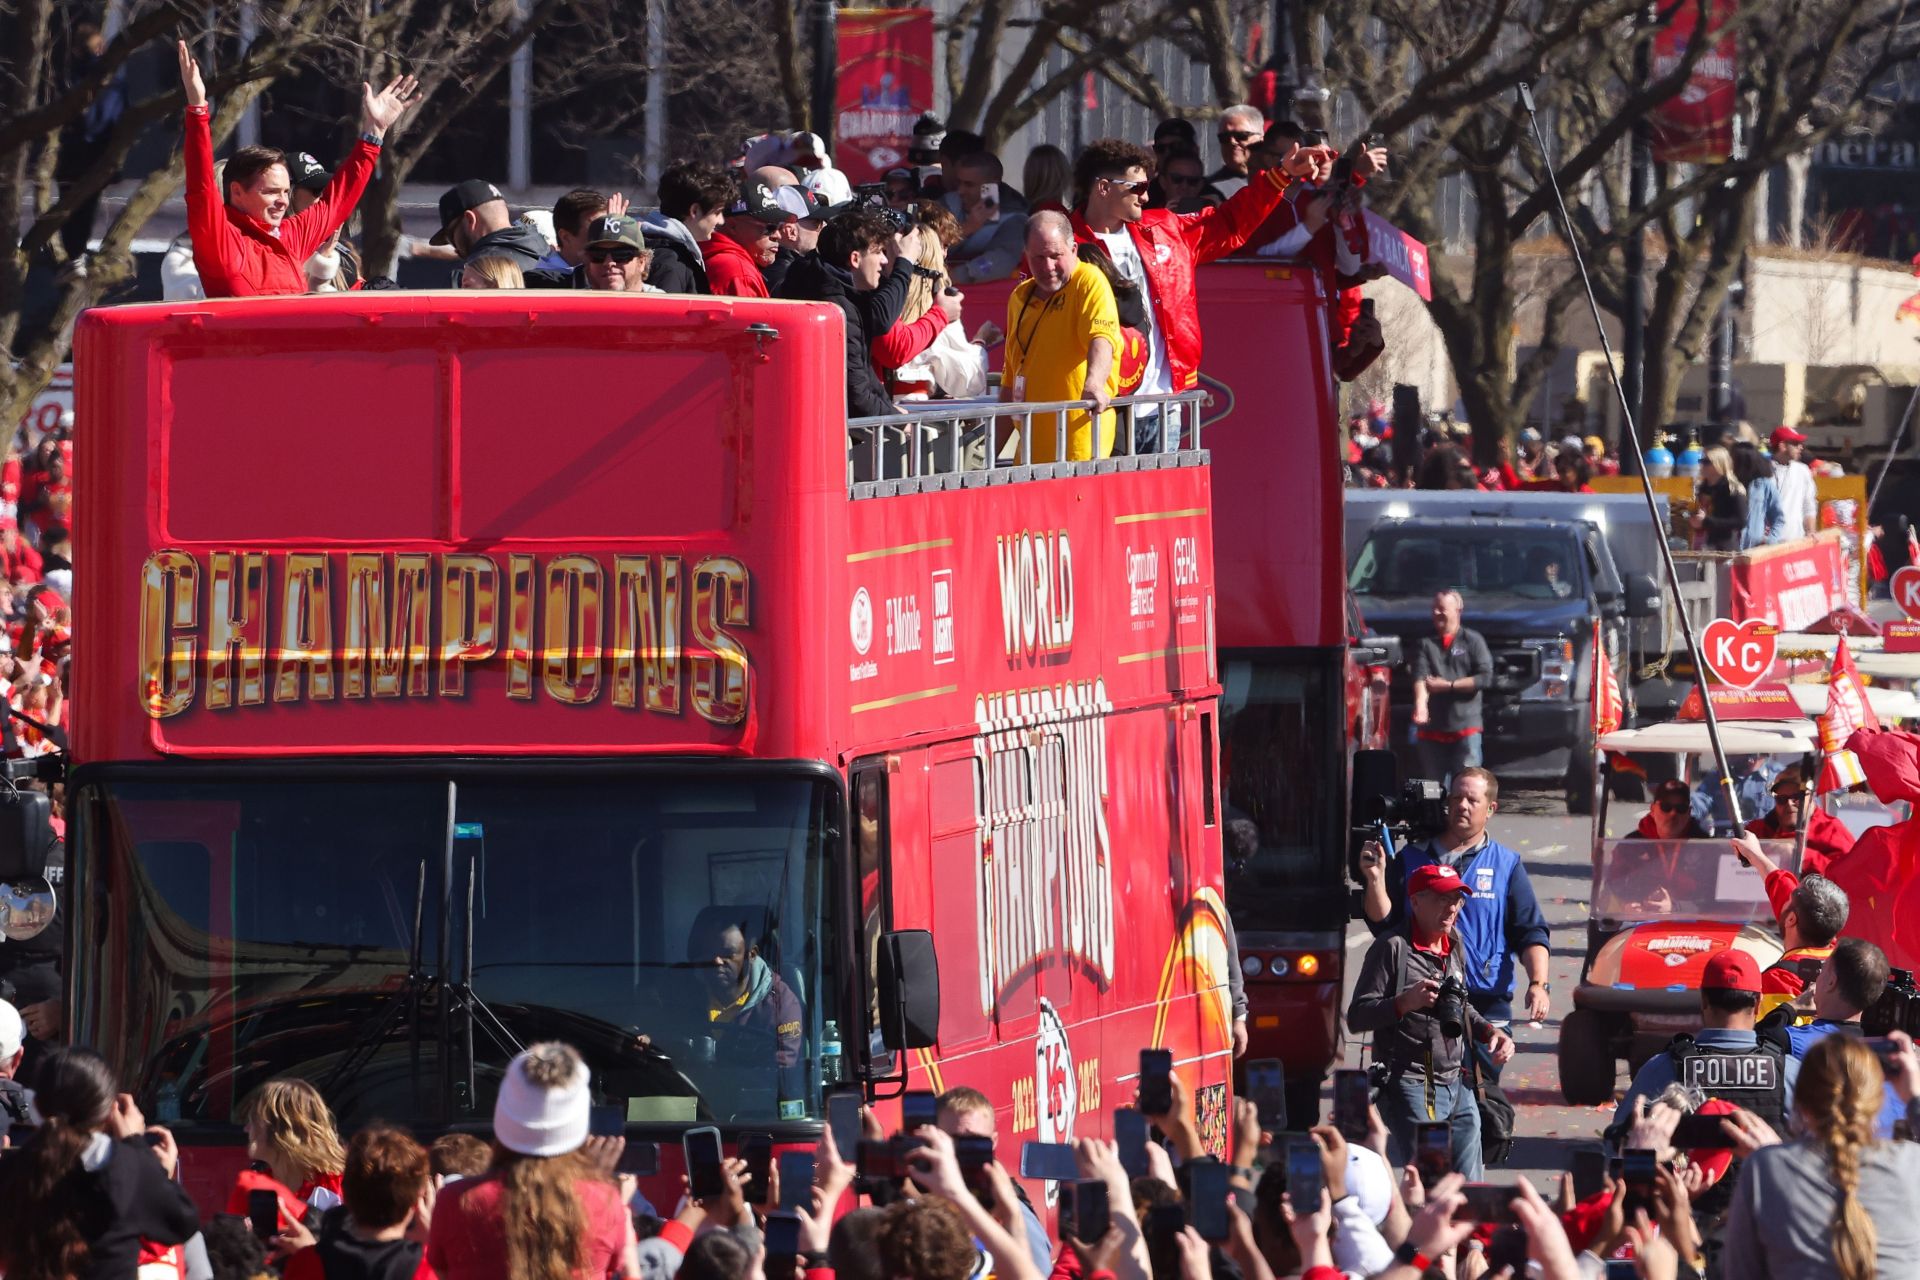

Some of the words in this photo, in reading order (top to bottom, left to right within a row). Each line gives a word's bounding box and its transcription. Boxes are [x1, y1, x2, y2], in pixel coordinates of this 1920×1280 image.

[604, 218, 620, 233] KC
[1126, 544, 1159, 588] Community
[1173, 537, 1199, 586] GEHA
[934, 581, 949, 617] BUD
[997, 528, 1075, 655] WORLD
[1905, 581, 1920, 607] K
[138, 548, 750, 725] CHAMPIONS
[933, 617, 953, 654] LIGHT
[1717, 636, 1762, 673] KC
[1692, 1058, 1768, 1085] POLICE
[1012, 1075, 1036, 1134] 2022
[1078, 1057, 1100, 1114] 2023
